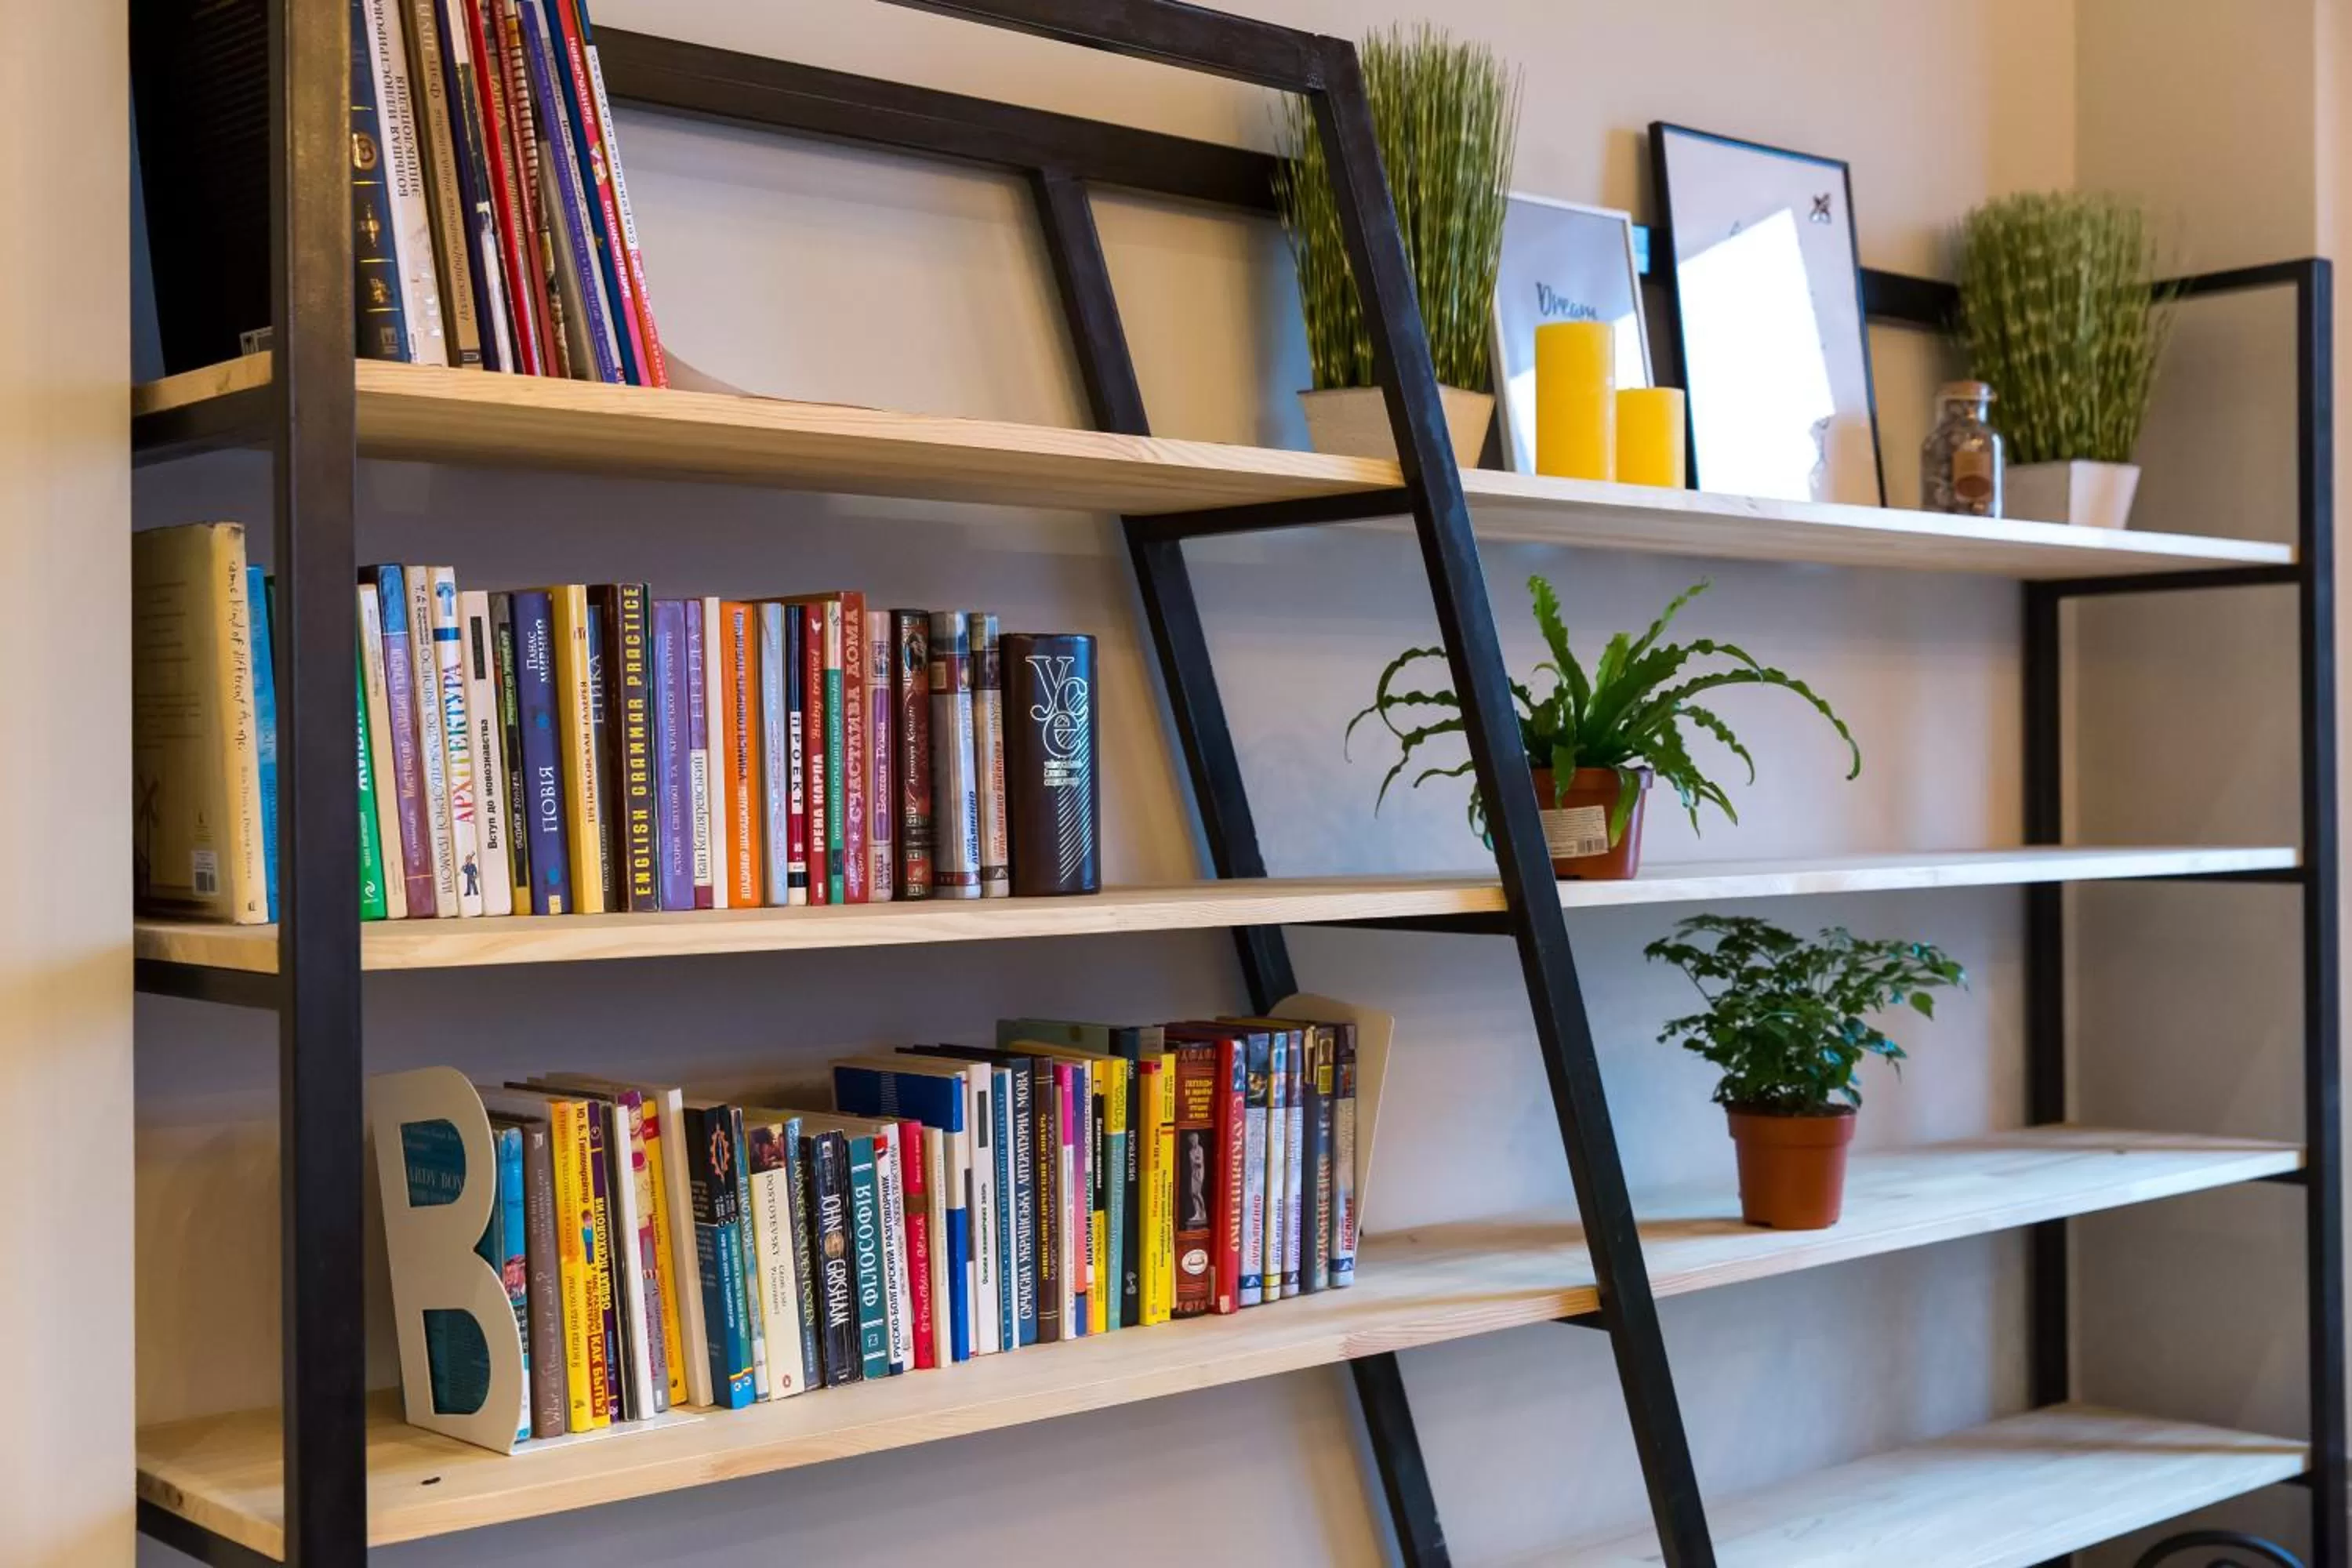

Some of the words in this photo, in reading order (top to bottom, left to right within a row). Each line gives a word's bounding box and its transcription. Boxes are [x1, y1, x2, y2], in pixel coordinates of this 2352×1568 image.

[388, 125, 409, 198] БОЛЬШАЯ
[394, 75, 422, 197] ЭНЦИКЛОПЕДИЯ
[1535, 281, 1598, 320] Dream
[621, 587, 644, 685] PRACTICE
[845, 608, 860, 677] ДОМА
[441, 662, 474, 824] АРХІТЕКТУРА
[479, 719, 493, 796] мовознавства
[626, 698, 648, 795] GRAMMAR
[737, 734, 747, 779] УЧИМСЯ
[789, 717, 803, 806] ПРОЕКТ
[846, 686, 862, 822] СЧАСТЛИВА
[485, 800, 495, 813] до
[537, 764, 558, 832] ПОВІЯ
[690, 756, 709, 850] Котляревський
[811, 753, 823, 804] КАРПА
[485, 818, 498, 848] Вступ
[630, 808, 652, 895] ENGLISH
[812, 809, 824, 851] ІРЕНА
[969, 789, 978, 864] ЛУКЬЯНЕНКО
[694, 854, 707, 878] Іван
[576, 1107, 586, 1120] Ю.
[1015, 1070, 1029, 1106] МОВА
[577, 1123, 586, 1134] Б.
[1016, 1111, 1029, 1184] ЛІТЕРАТУРНА
[1127, 1129, 1136, 1181] DEUTSCH
[765, 1174, 780, 1256] DOSTOYEVSKY
[792, 1160, 807, 1219] JAPANESE
[819, 1193, 844, 1232] JOHN
[880, 1175, 895, 1247] РАЗГОВОРНИК
[796, 1221, 811, 1277] GOLDEN
[854, 1183, 879, 1306] ФІЛОСОФІЯ
[1017, 1190, 1031, 1261] УКРАЇНСЬКА
[599, 1272, 612, 1309] ОБЩАЯ
[800, 1279, 815, 1326] DOZEN
[824, 1258, 849, 1327] GRISHAM
[885, 1249, 902, 1358] РУССКО-БОЛГАРСКИЙ
[1018, 1265, 1032, 1319] СУЧАСНА
[590, 1335, 602, 1363] КАК
[593, 1367, 605, 1414] БЫТЬ?
